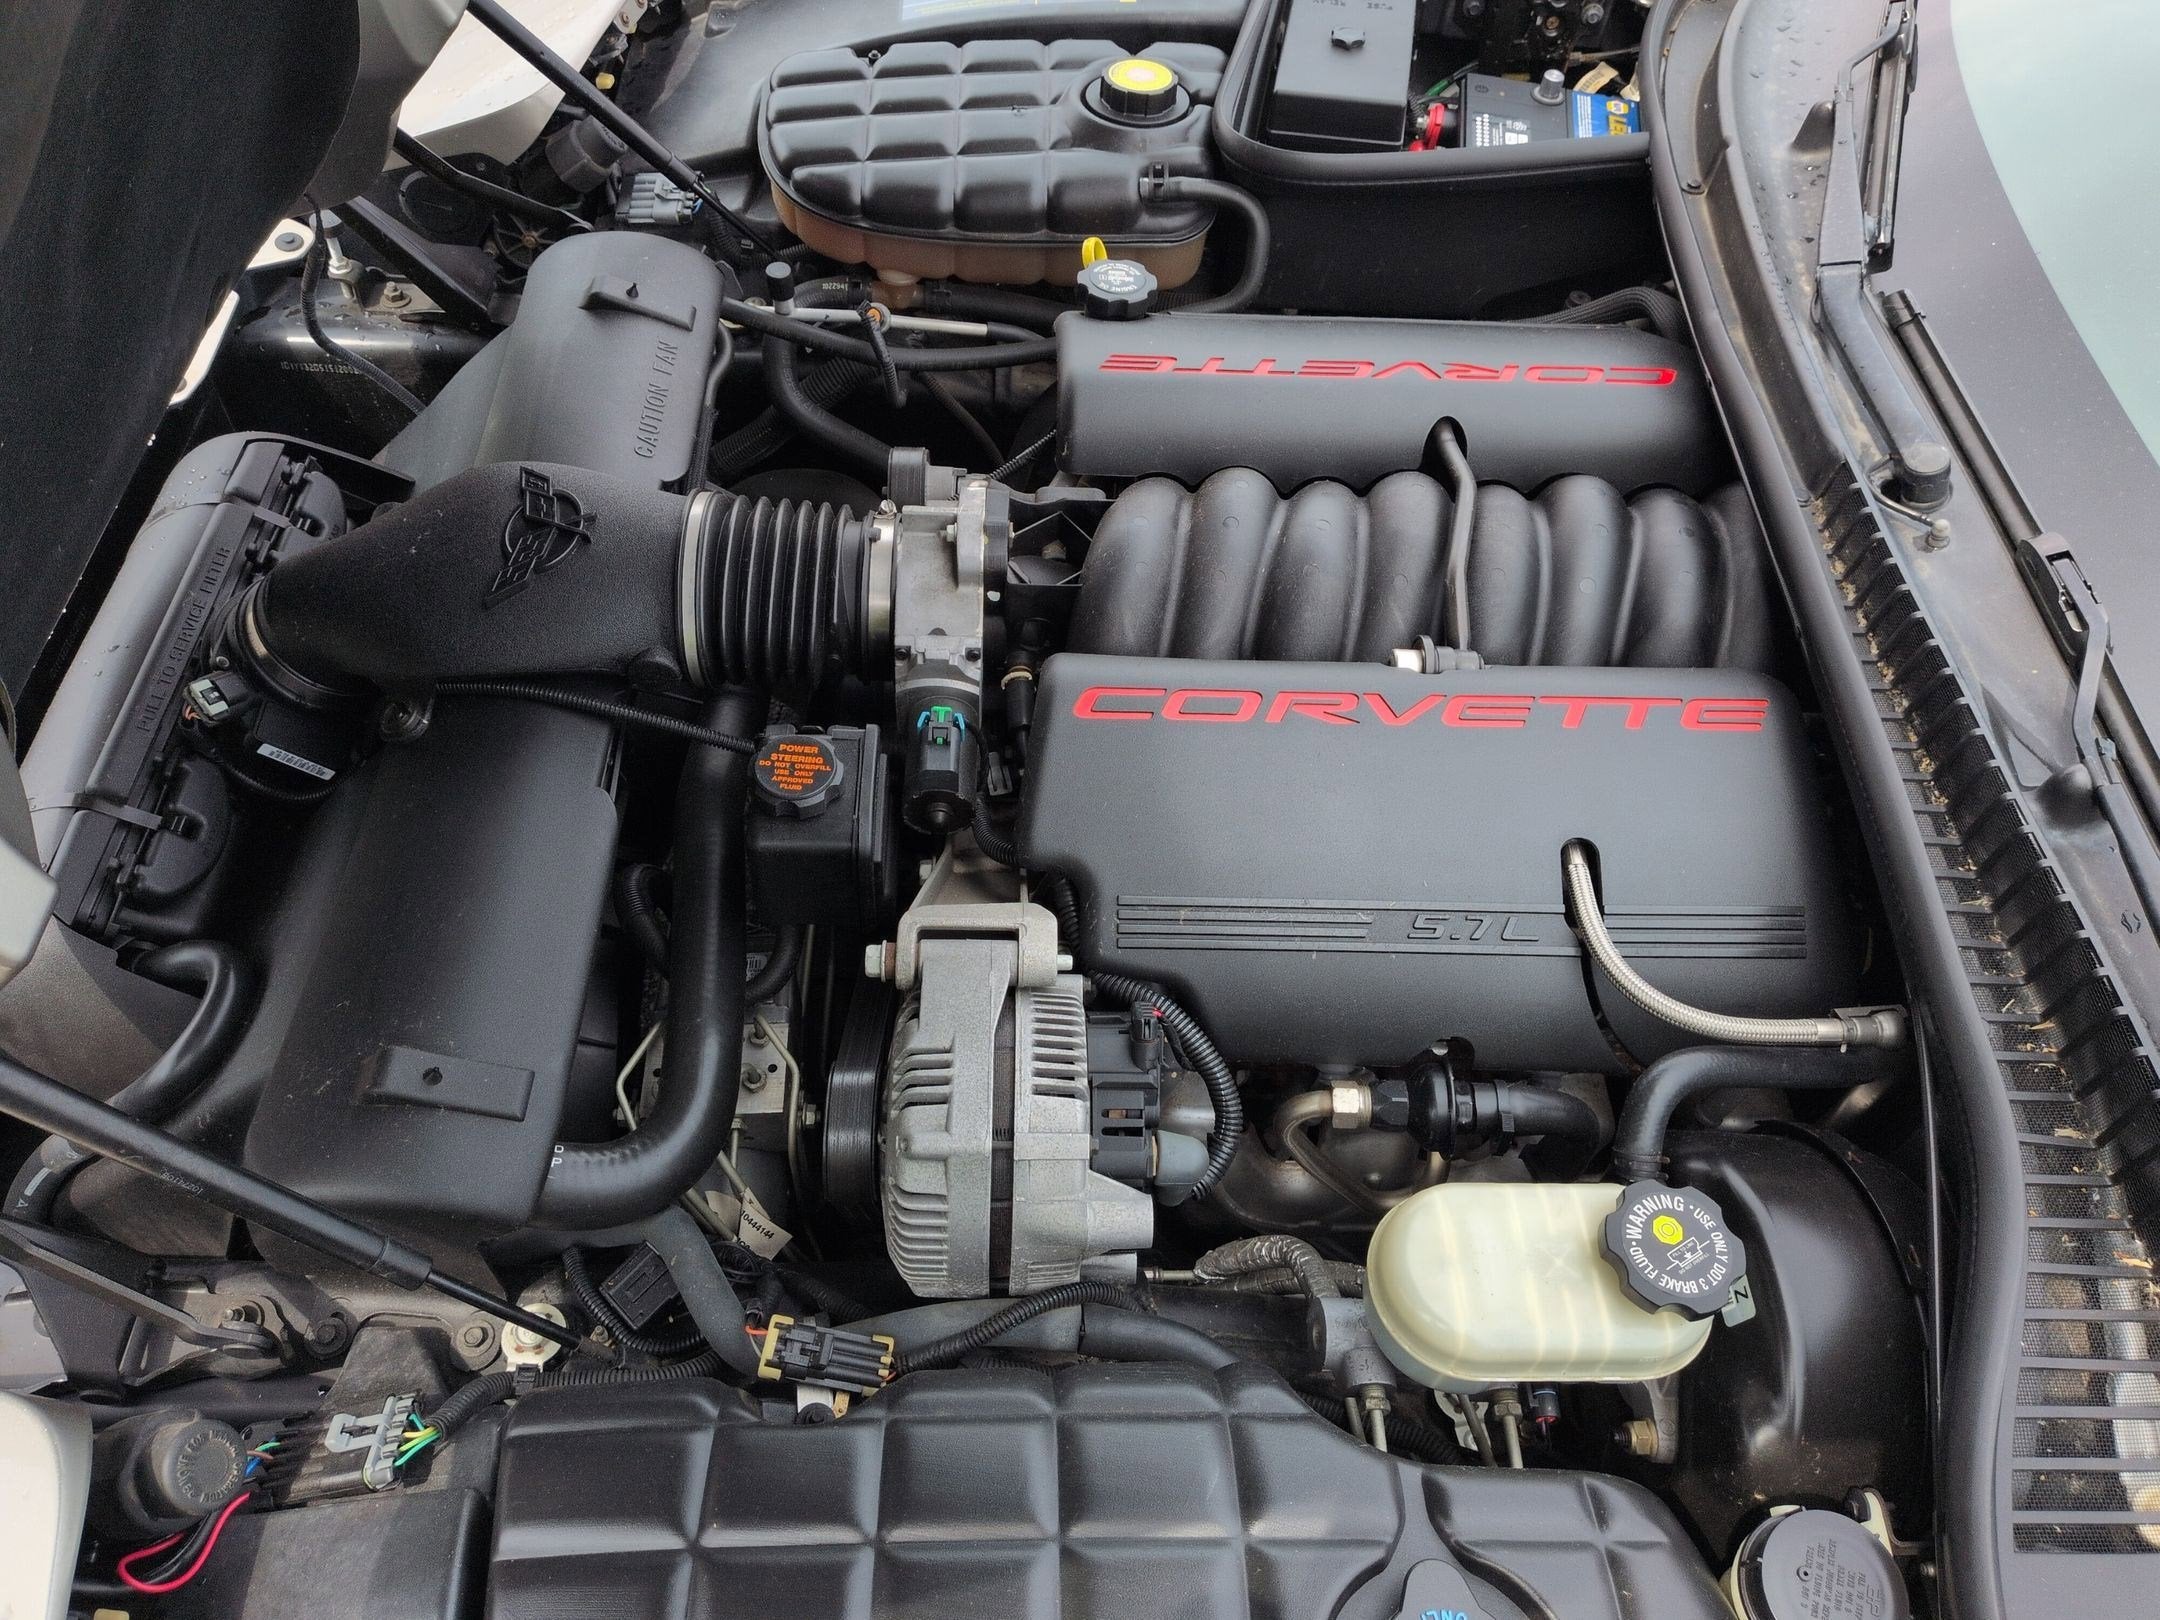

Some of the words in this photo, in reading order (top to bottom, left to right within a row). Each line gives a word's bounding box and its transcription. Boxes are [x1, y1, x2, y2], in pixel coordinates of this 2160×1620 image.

[1099, 353, 1678, 386] CORVETTE
[634, 382, 669, 458] CAUTION
[652, 340, 679, 376] FAN
[137, 689, 170, 732] PULL
[157, 666, 176, 687] TO
[169, 602, 206, 662] SERVICE
[200, 547, 231, 595] FILTER
[1072, 686, 1771, 731] CORVETTE
[771, 753, 824, 764] STEERING
[779, 743, 819, 754] POWER
[771, 775, 814, 784] APPROVED
[794, 763, 832, 771] OVERFILL
[779, 783, 803, 791] FLUID
[1407, 913, 1540, 941] 5.7L
[740, 1210, 775, 1239] 10444144
[1626, 1194, 1684, 1240] WARNING
[1693, 1206, 1716, 1230] USE
[1710, 1231, 1729, 1264] ONLY
[1629, 1247, 1659, 1280] FLUID
[1706, 1262, 1727, 1286] DOT
[1658, 1274, 1699, 1294] BRAKE
[1699, 1278, 1709, 1291] 3
